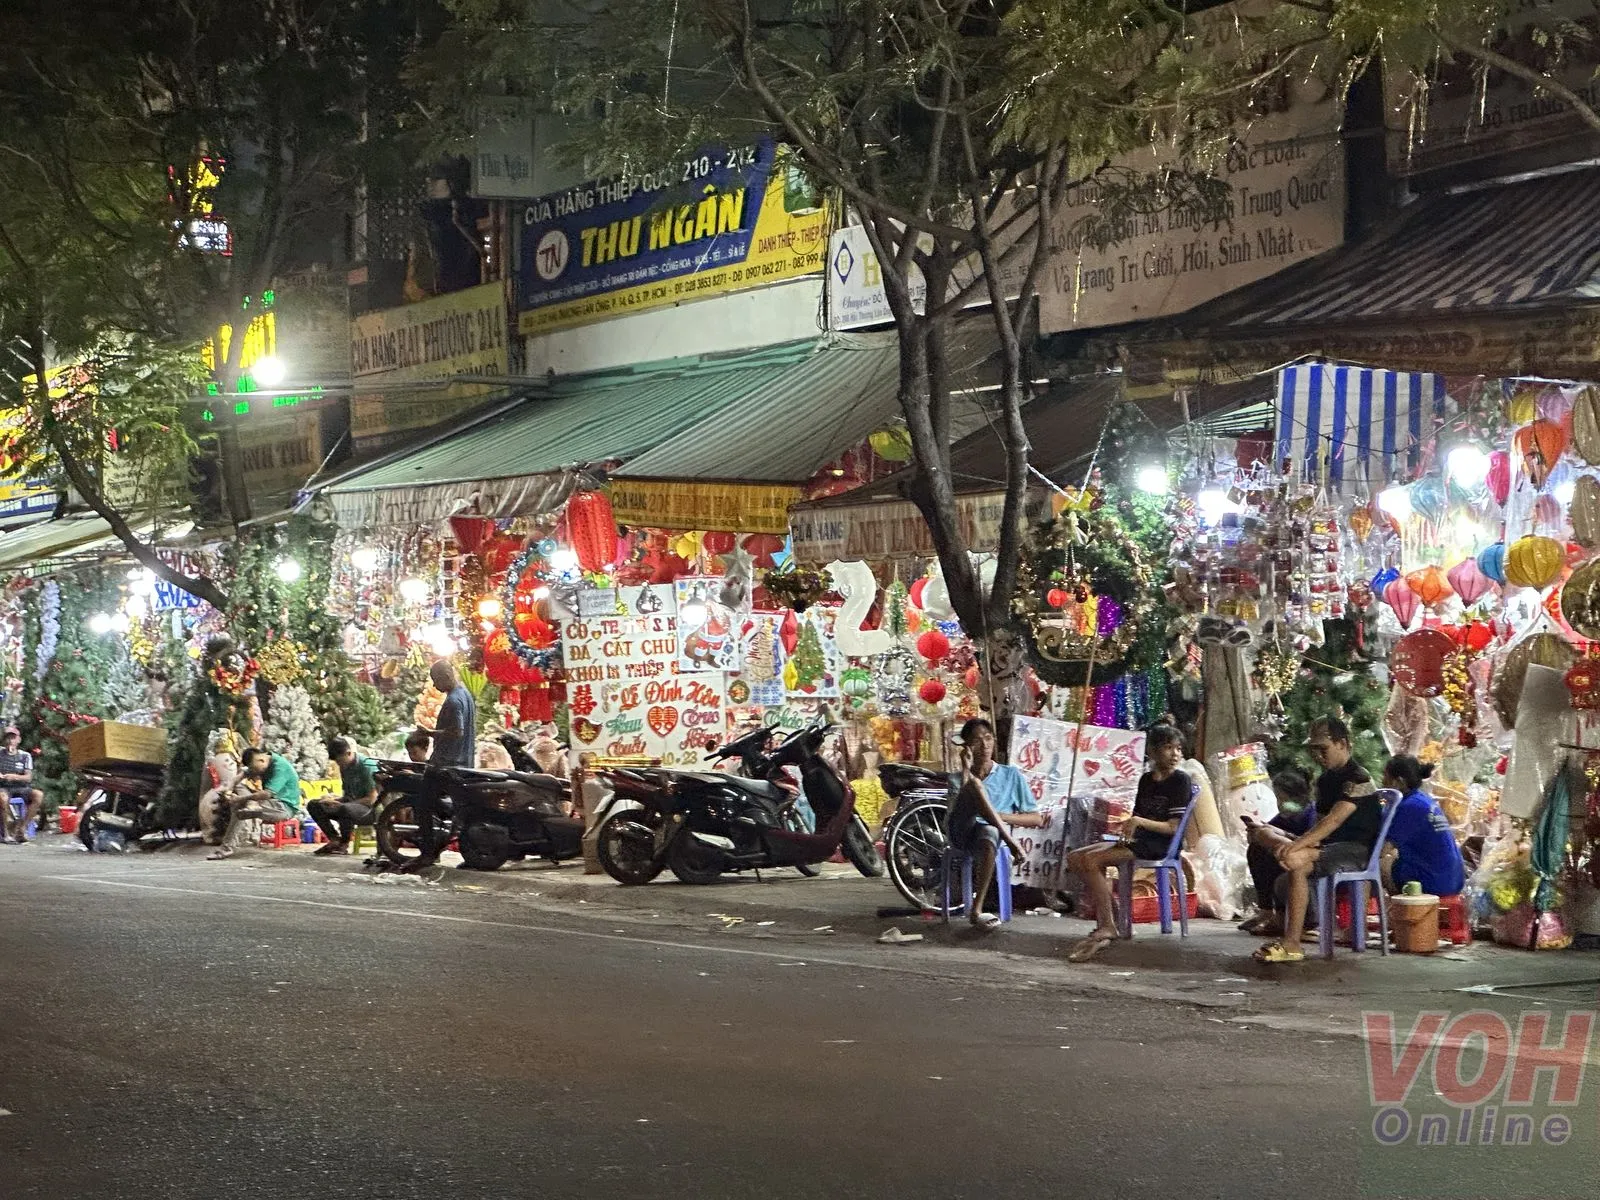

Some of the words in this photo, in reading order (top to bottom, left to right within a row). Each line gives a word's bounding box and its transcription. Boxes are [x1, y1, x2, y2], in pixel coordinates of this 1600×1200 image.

[682, 155, 709, 182] 210
[648, 183, 745, 252] NGÂN
[1239, 186, 1282, 218] Trung
[1218, 231, 1251, 267] Sinh
[1255, 226, 1295, 262] Nhật
